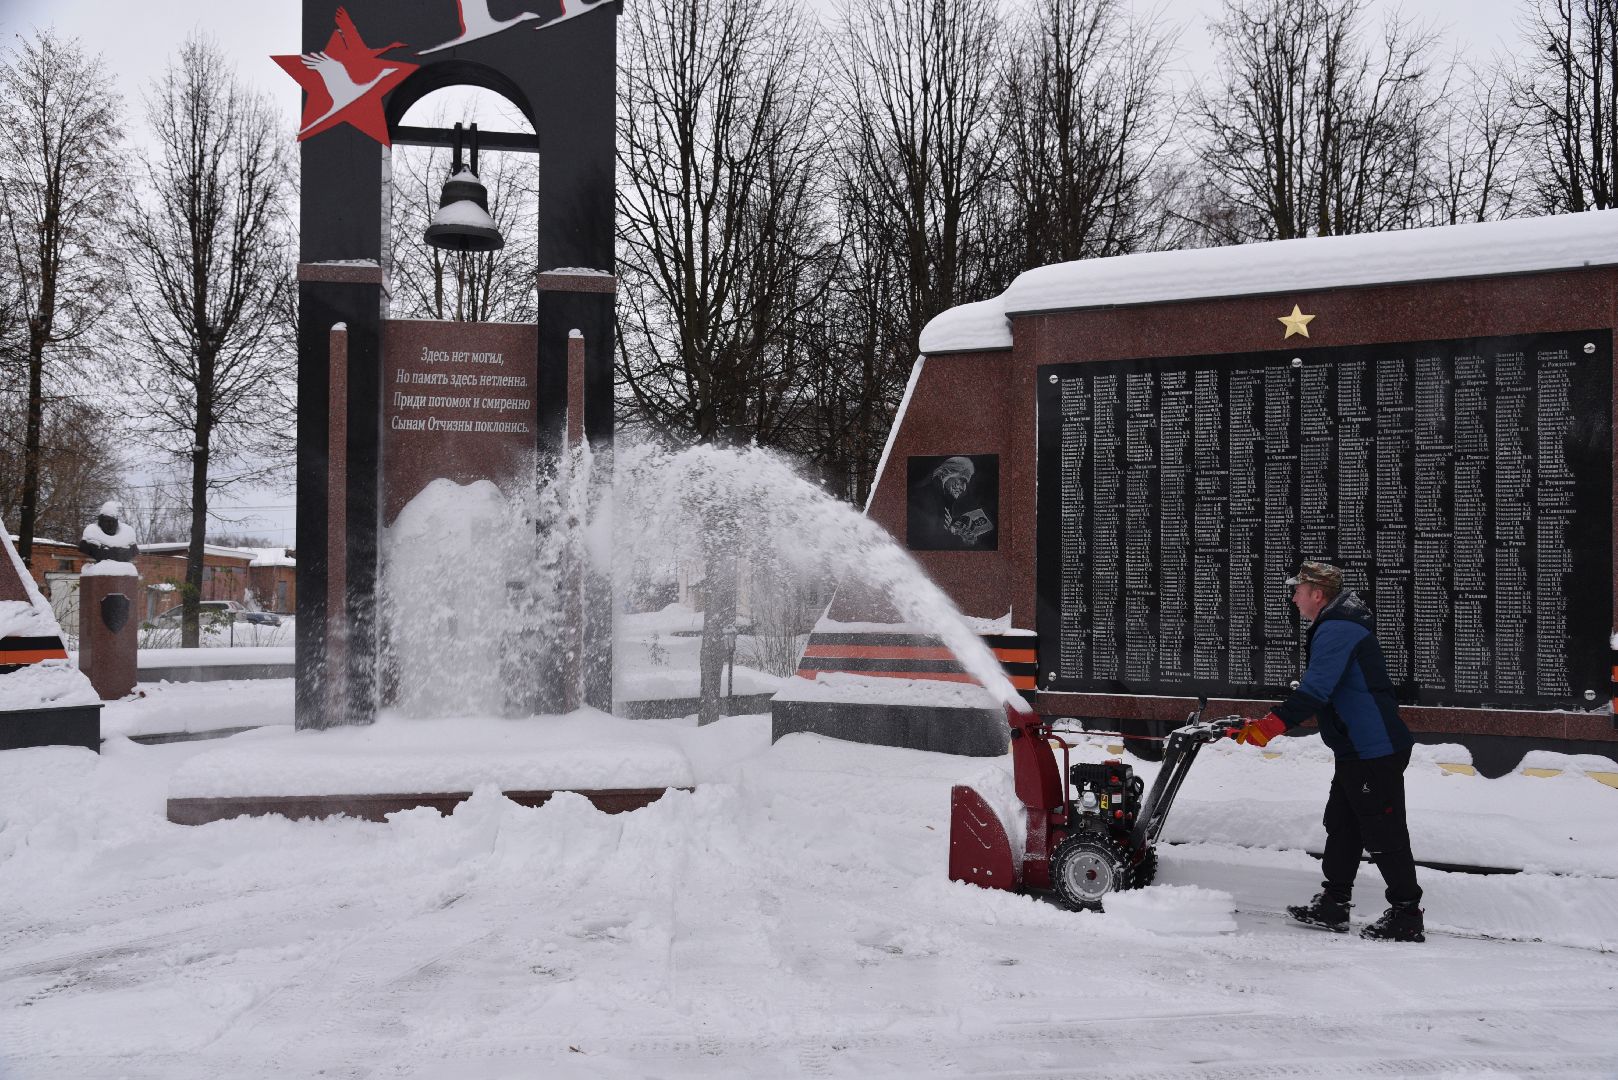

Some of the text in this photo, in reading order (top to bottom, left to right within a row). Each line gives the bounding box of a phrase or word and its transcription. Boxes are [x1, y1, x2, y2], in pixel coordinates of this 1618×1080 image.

[421, 347, 504, 366] Здесь нет могил,
[396, 369, 528, 387] Но память здесь нетленна.
[394, 392, 530, 412] Приди потомок и смиренно
[392, 416, 529, 433] Сынам Отчизны поклонись.
